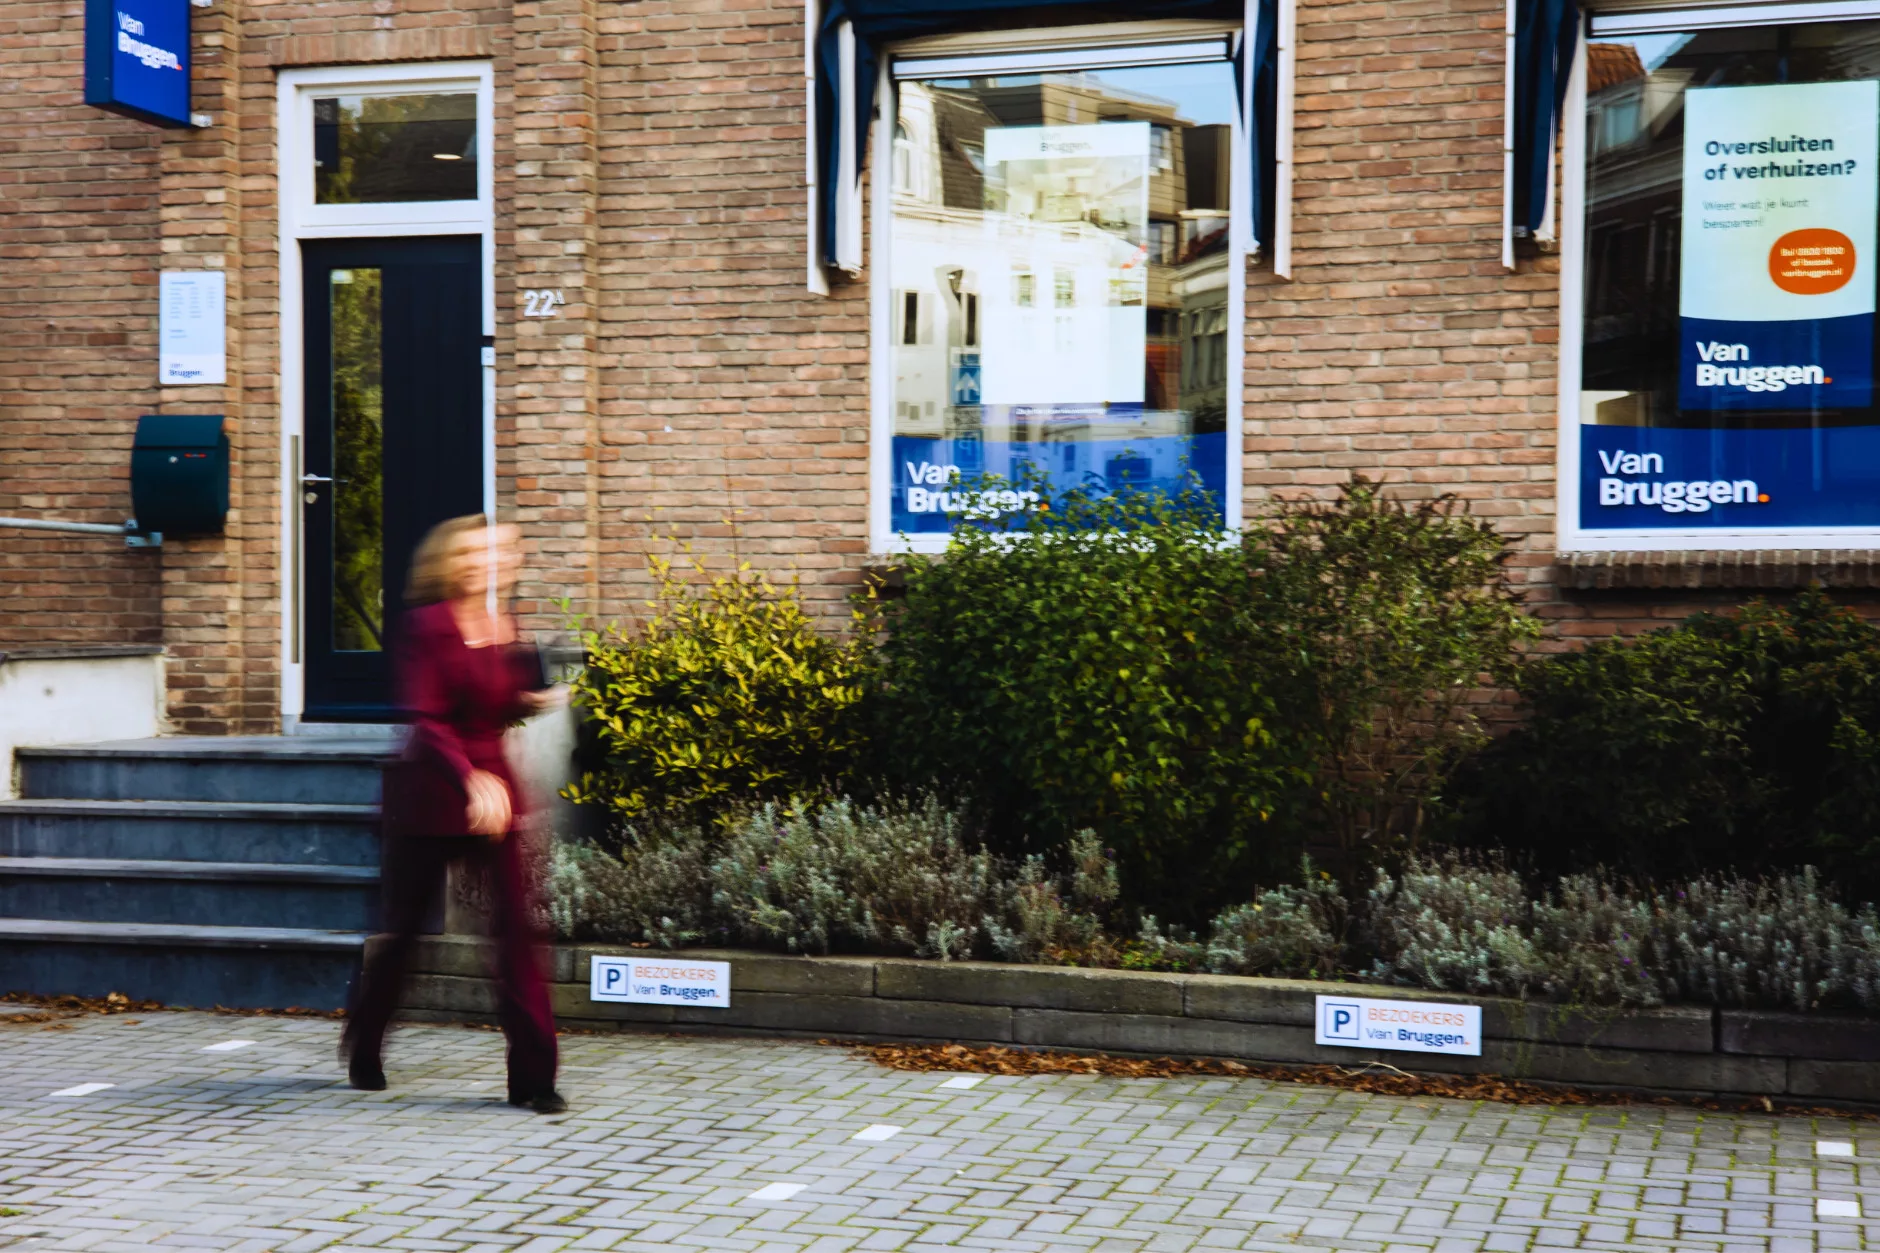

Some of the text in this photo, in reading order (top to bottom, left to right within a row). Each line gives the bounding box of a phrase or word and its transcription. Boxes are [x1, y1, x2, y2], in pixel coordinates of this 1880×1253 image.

[117, 10, 144, 36] Van
[1705, 134, 1835, 156] Oversluiten
[1704, 159, 1857, 180] of verhuizen?
[1702, 196, 1809, 212] Weet wat je kunt
[1696, 341, 1749, 361] Van
[1696, 363, 1832, 392] Bruggen.
[906, 461, 961, 484] Van
[1598, 449, 1664, 475] Van
[1599, 478, 1770, 513] Bruggen.
[606, 968, 622, 990] P
[634, 966, 717, 981] BEZOEKERS
[632, 984, 720, 1000] Van Bruggen.
[1334, 1010, 1351, 1033] P
[1367, 1007, 1465, 1026] BEZOEKERS
[1366, 1027, 1471, 1047] Van Bruggen.
